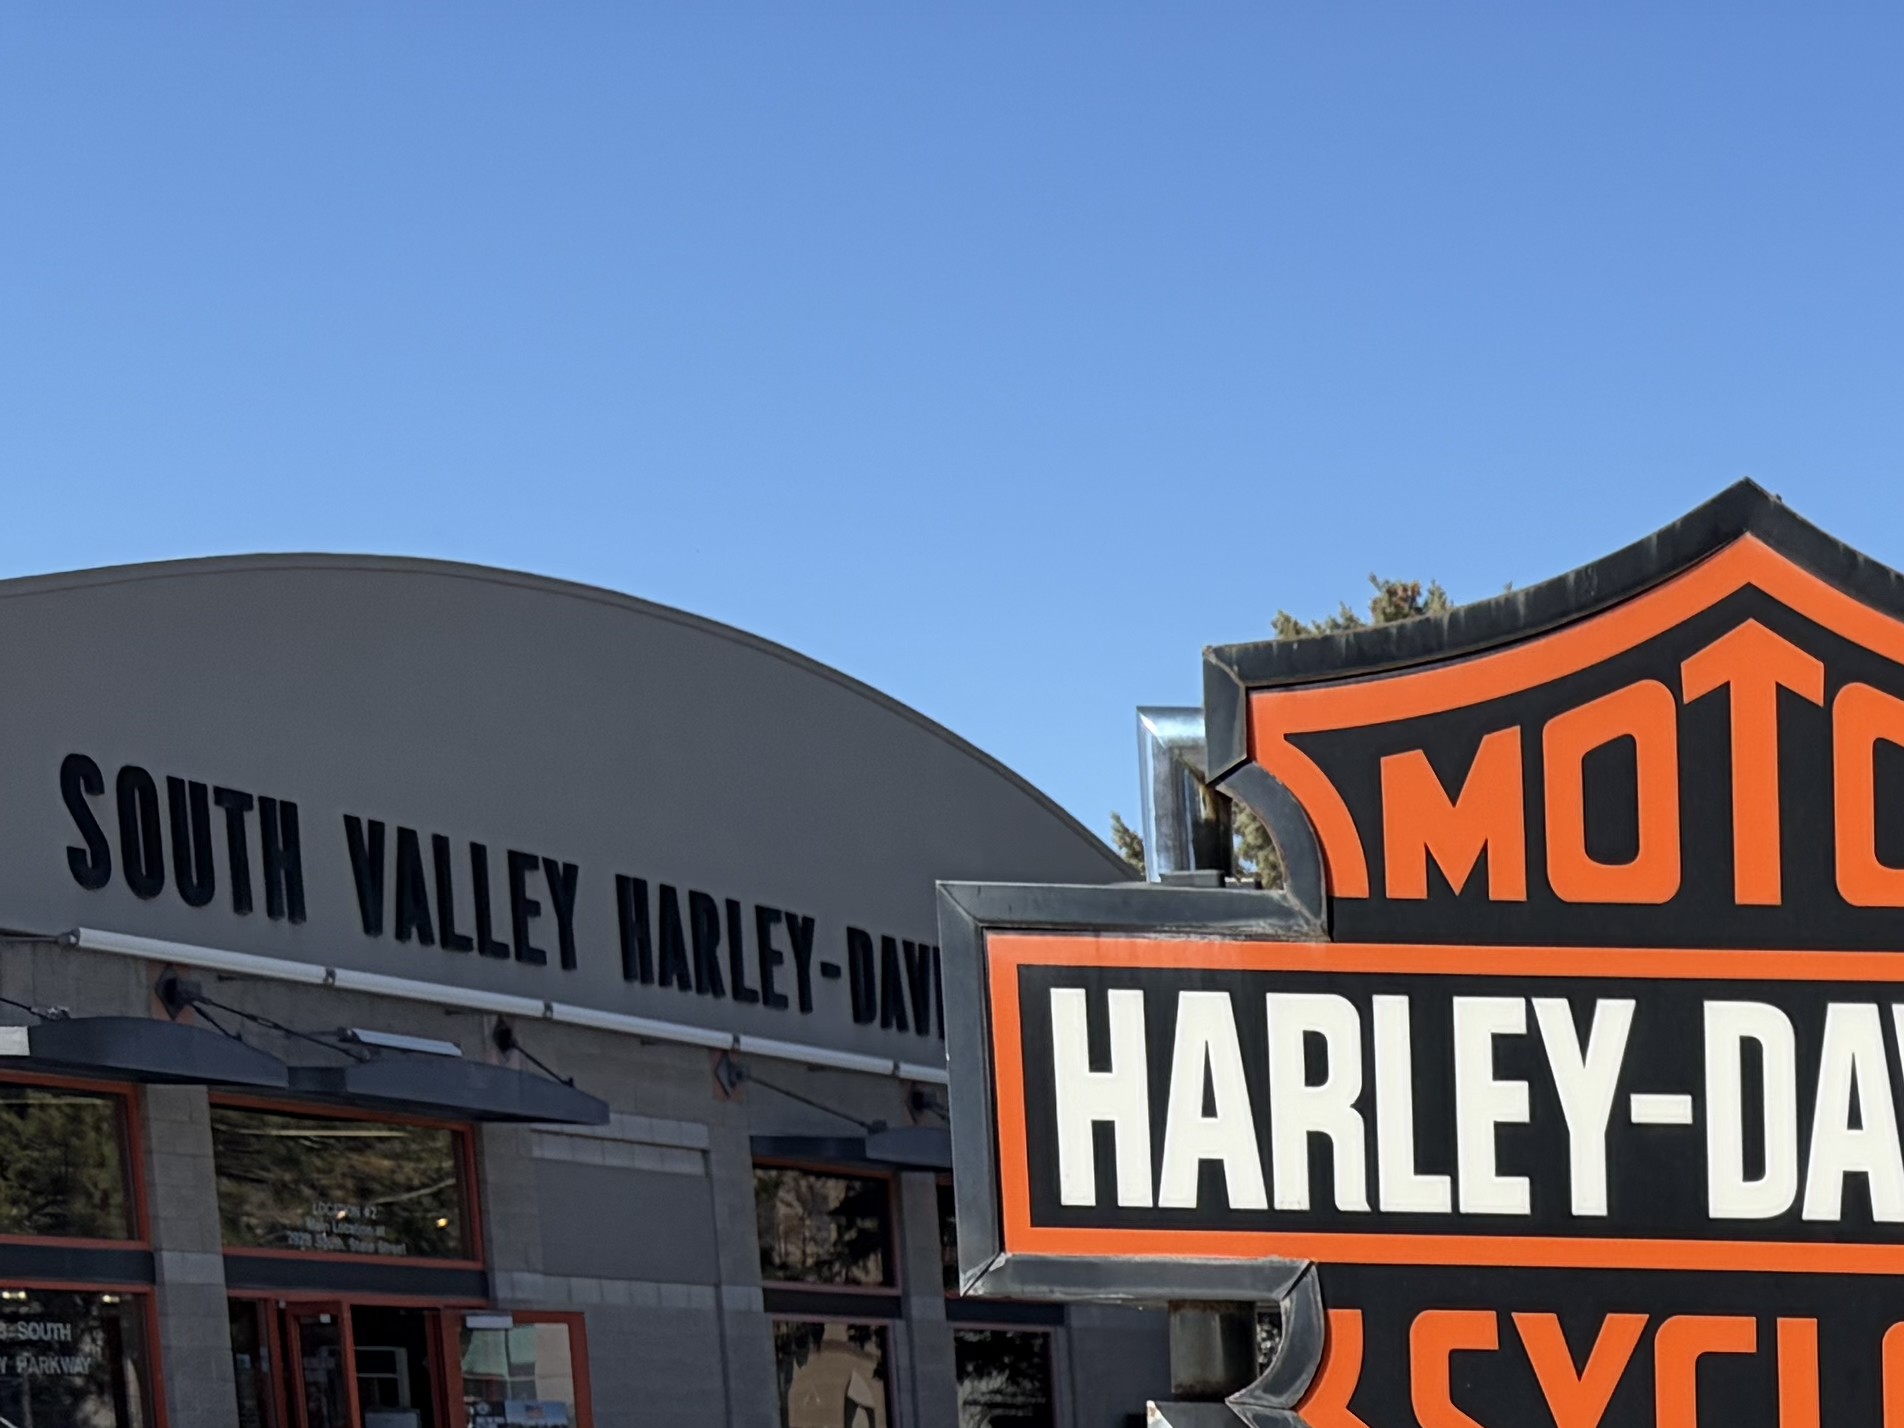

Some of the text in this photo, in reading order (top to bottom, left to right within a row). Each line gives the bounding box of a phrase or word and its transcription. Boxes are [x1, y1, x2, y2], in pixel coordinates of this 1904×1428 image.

[60, 753, 307, 924] SOUTH
[343, 813, 579, 971] VALLEY
[18, 1321, 72, 1342] SOUTH
[16, 1355, 91, 1375] PARKWAY
